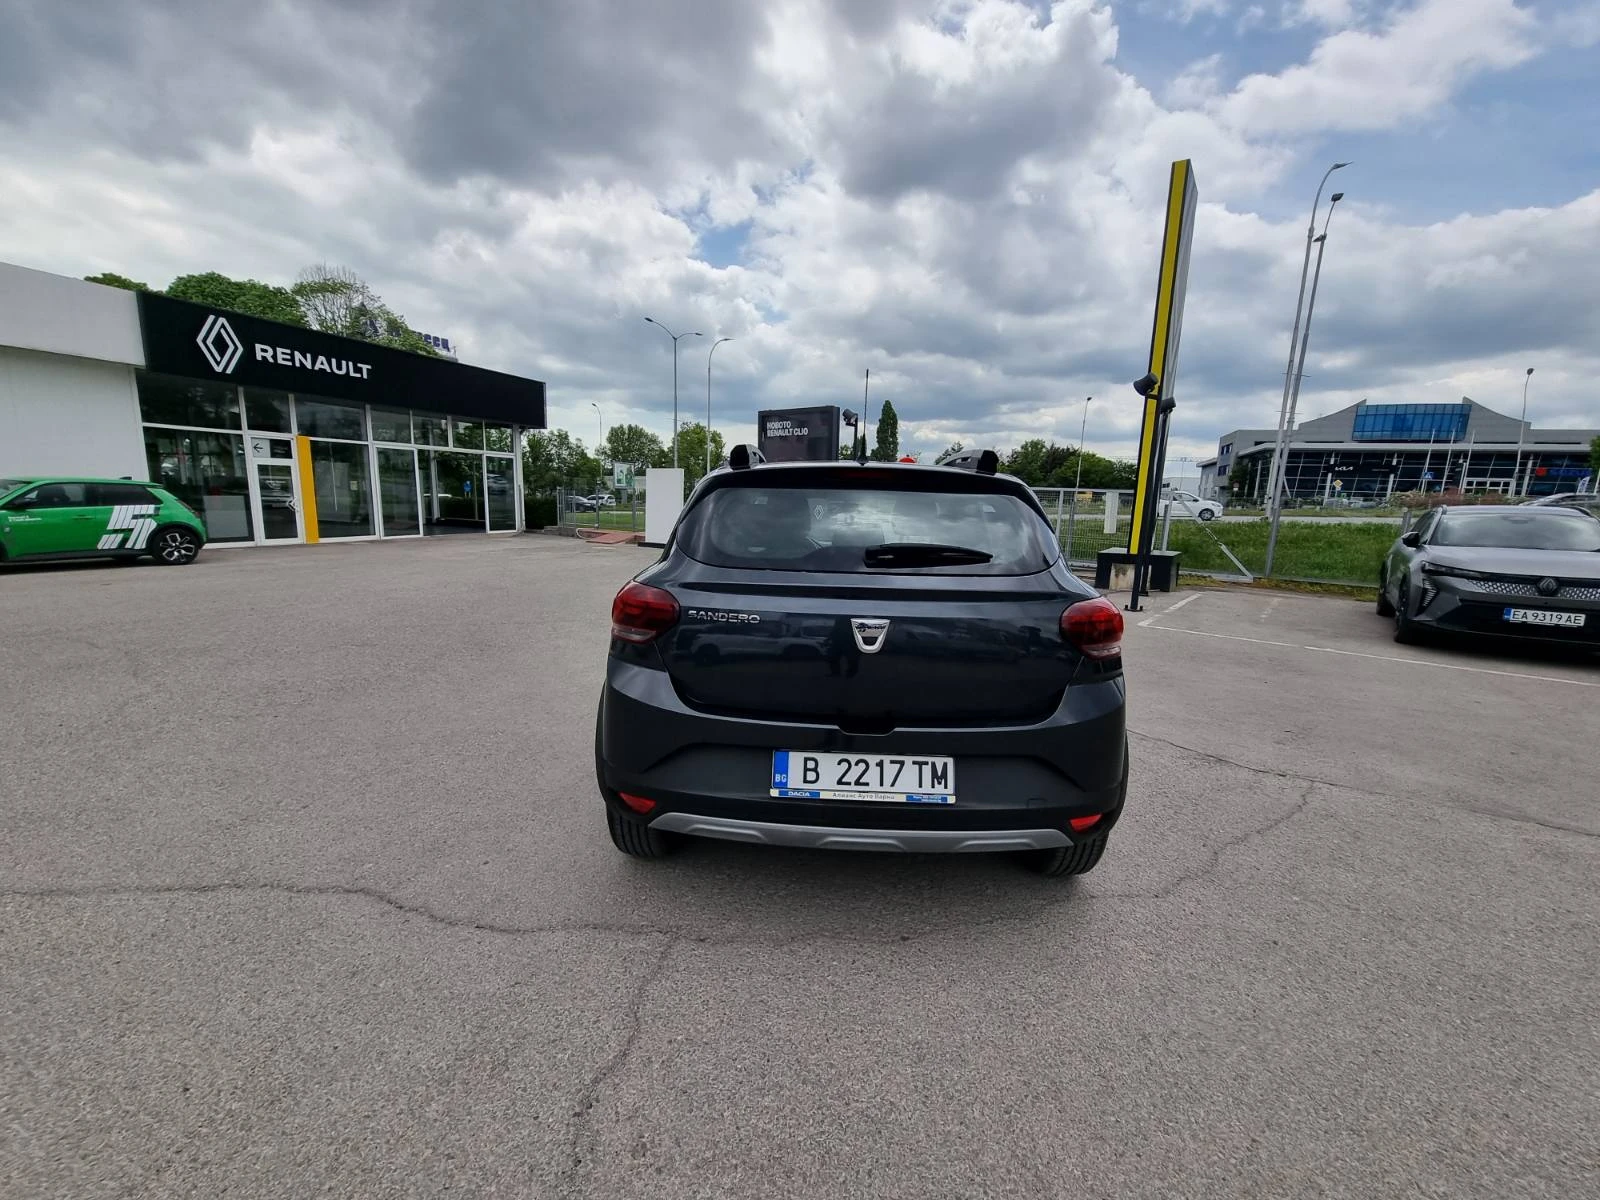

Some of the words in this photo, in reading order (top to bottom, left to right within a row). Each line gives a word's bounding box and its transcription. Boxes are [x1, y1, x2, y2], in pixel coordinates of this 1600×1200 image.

[254, 343, 372, 379] RENAULT
[767, 428, 793, 437] RENAULT
[793, 427, 809, 436] CLIO
[688, 610, 760, 623] SANDERO
[1512, 610, 1528, 620] EA
[1531, 612, 1563, 623] 9319
[1565, 614, 1583, 625] AE
[775, 773, 787, 783] BG
[803, 756, 820, 785] B
[836, 758, 906, 788] 2217
[912, 760, 948, 790] TM
